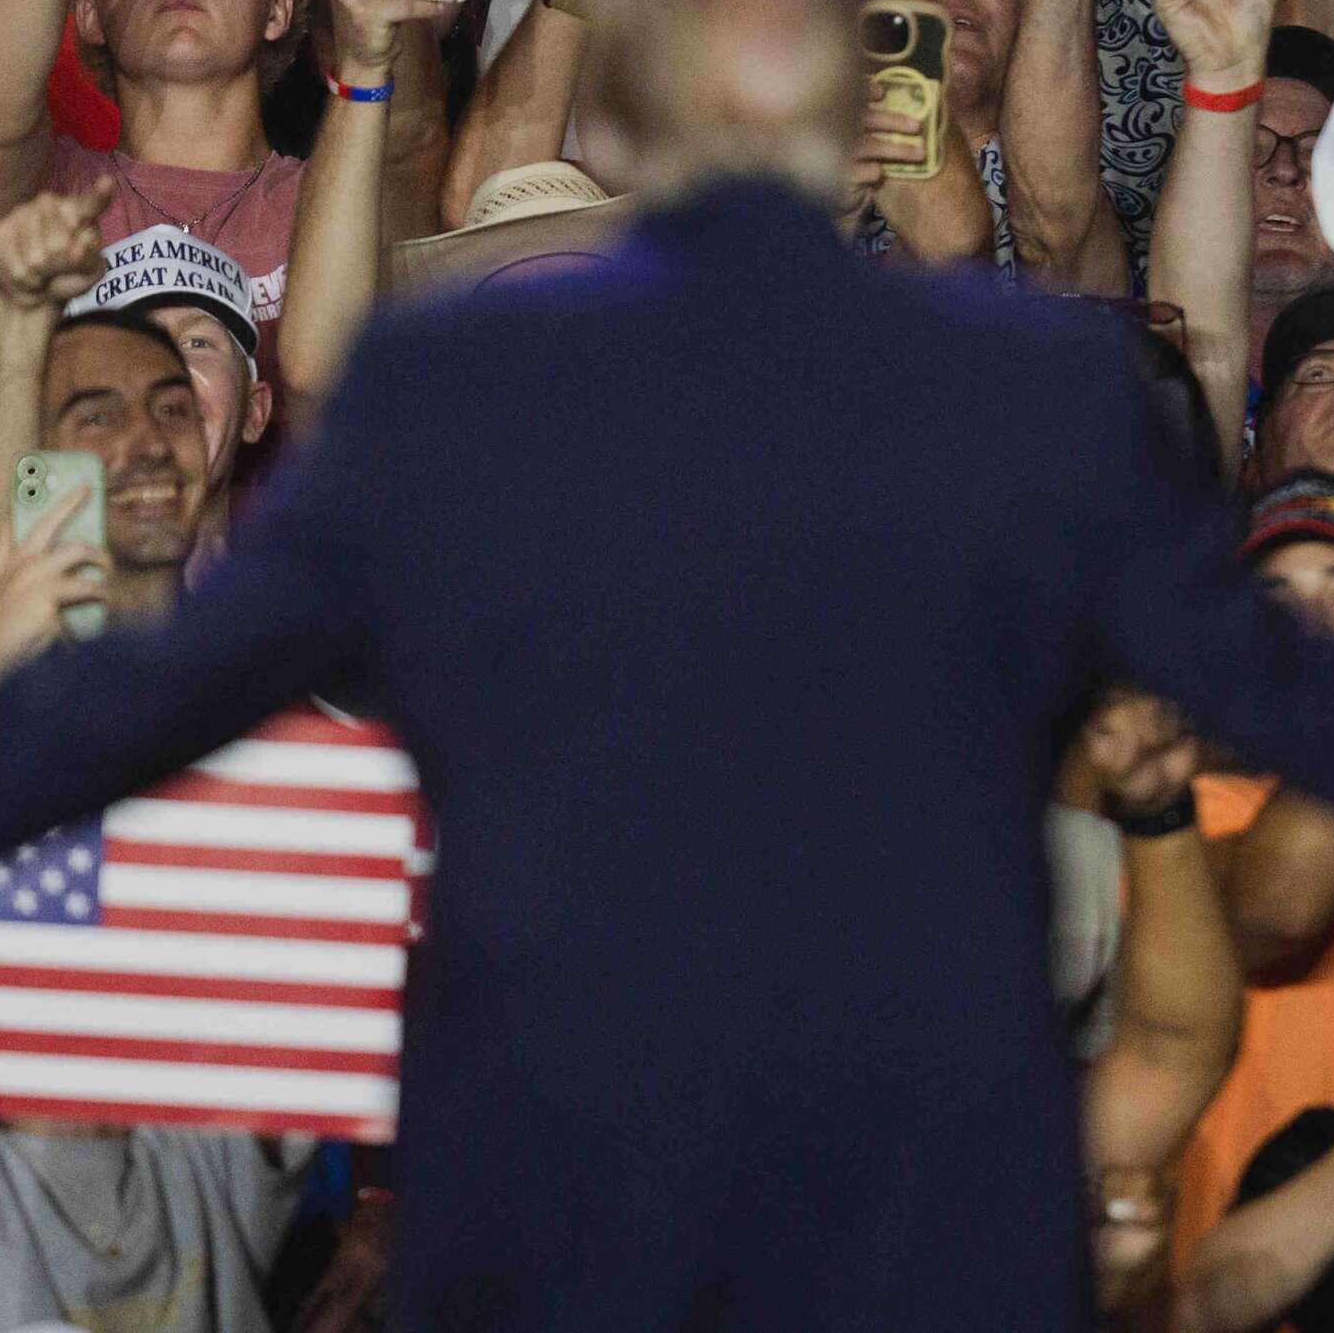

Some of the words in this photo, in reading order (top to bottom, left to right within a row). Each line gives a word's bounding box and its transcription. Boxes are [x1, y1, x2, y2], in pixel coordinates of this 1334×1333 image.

[95, 267, 168, 307] GREAT
[174, 268, 236, 304] AGAIN
[107, 242, 145, 271] KE
[149, 239, 245, 294] AMERICA
